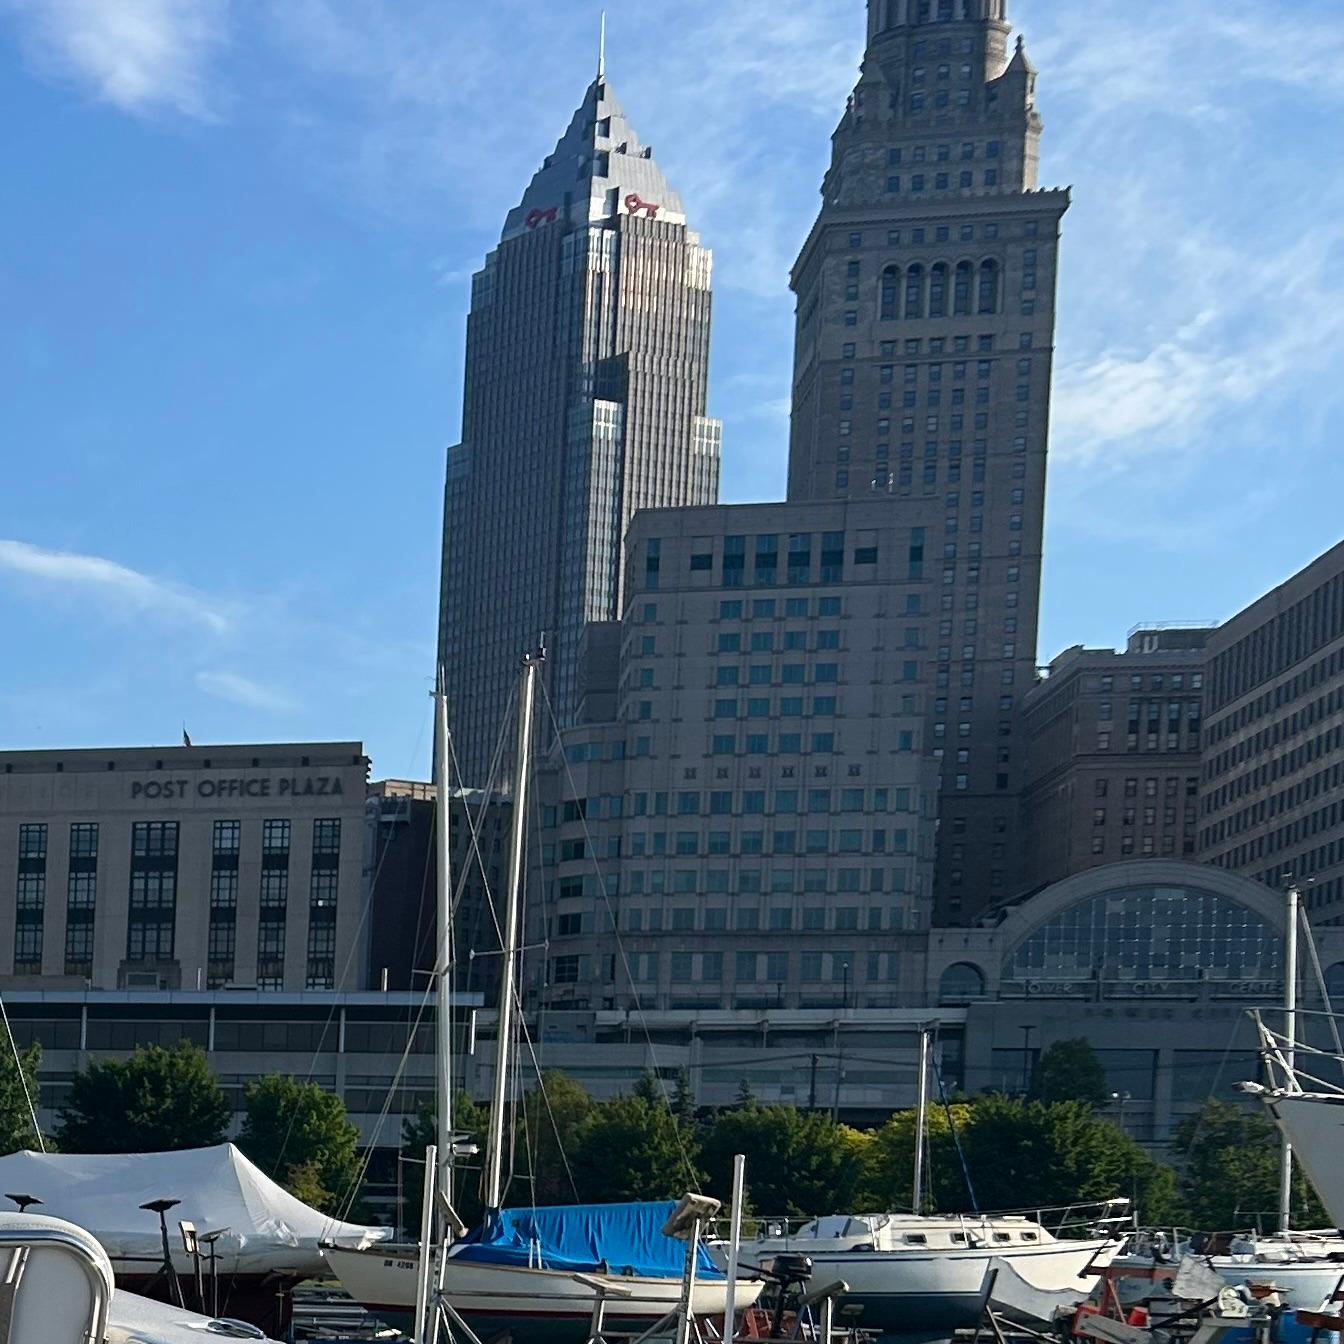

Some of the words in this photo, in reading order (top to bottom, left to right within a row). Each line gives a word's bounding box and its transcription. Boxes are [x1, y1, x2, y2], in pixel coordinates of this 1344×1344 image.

[131, 780, 187, 799] POST
[198, 778, 270, 798] OFFICE
[279, 776, 343, 796] PLAZA
[1132, 981, 1170, 993] CITY
[1230, 983, 1281, 994] CENTE
